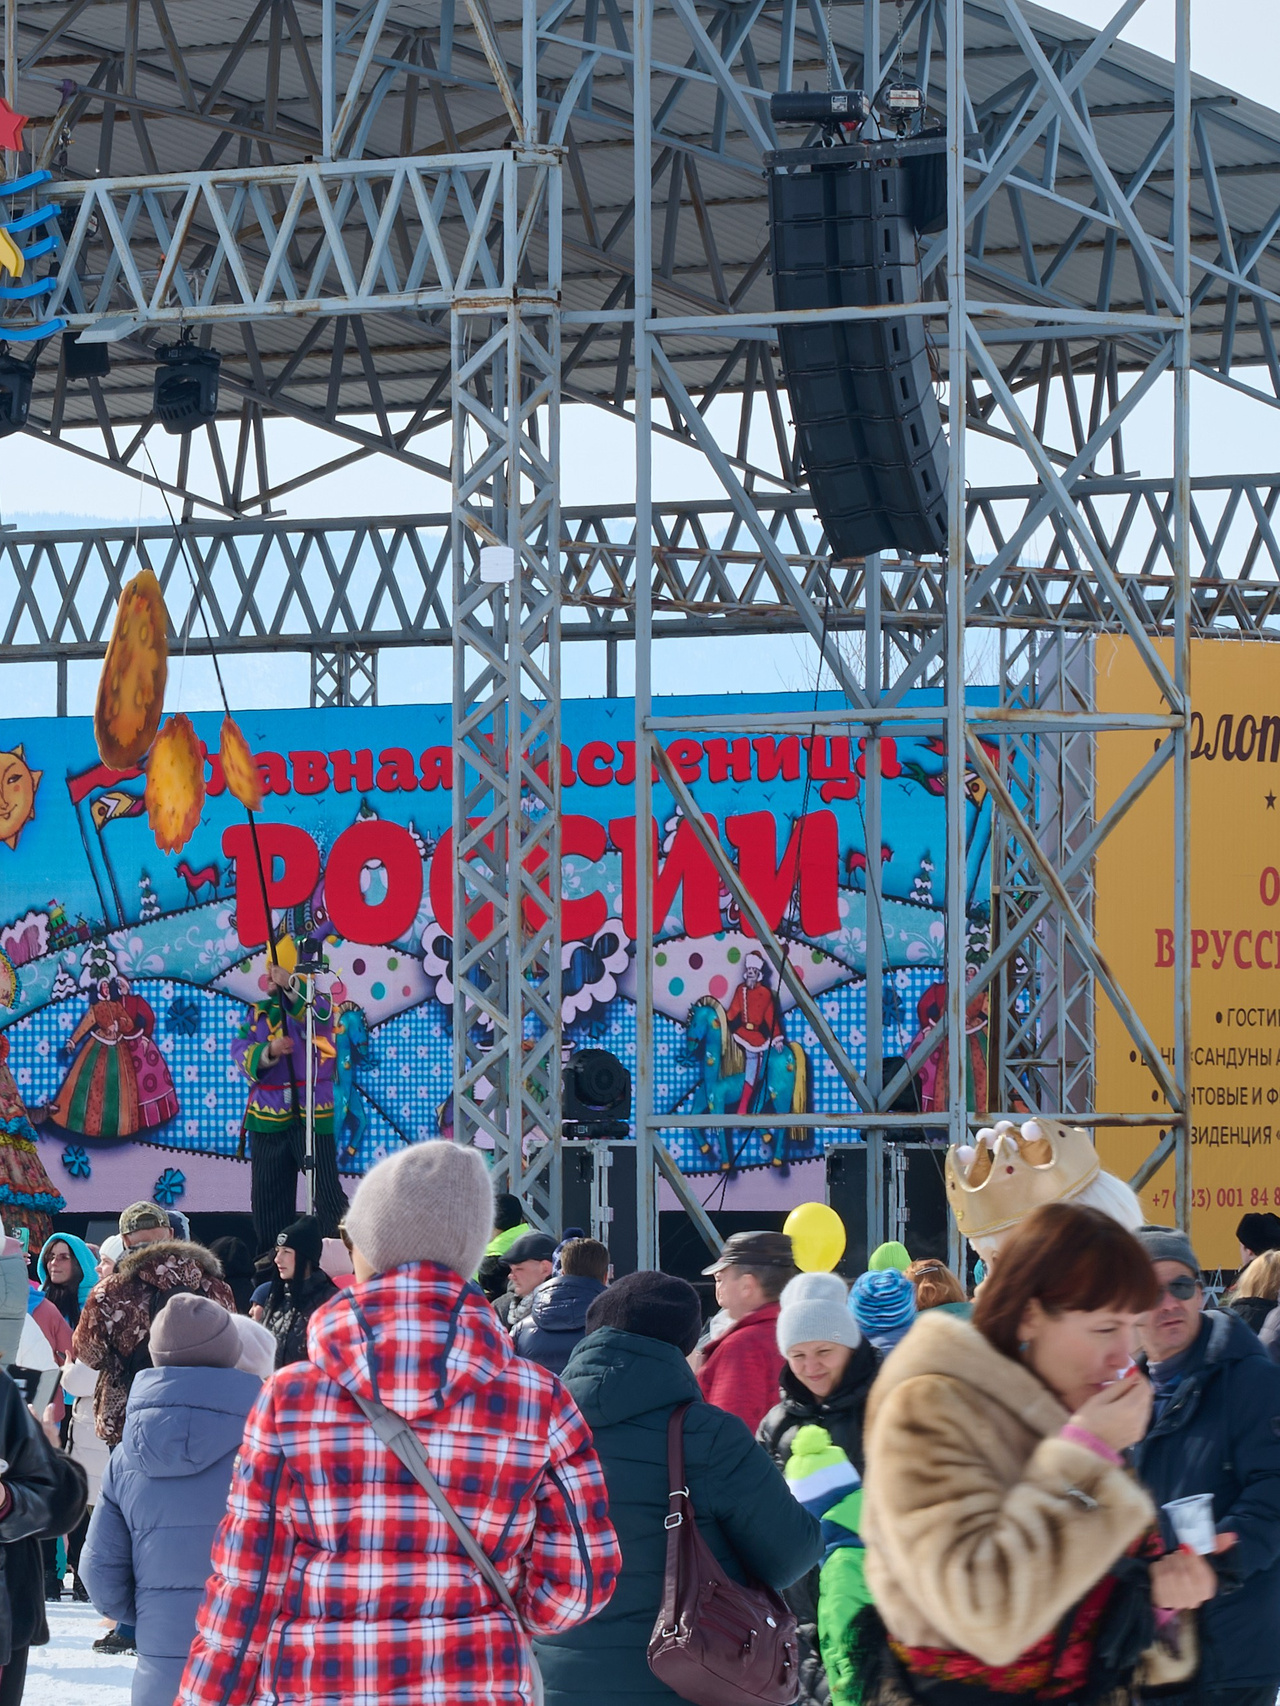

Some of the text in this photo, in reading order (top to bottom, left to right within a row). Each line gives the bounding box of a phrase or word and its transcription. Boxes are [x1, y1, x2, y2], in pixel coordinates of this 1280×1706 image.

[1190, 929, 1280, 970] РУСС
[1227, 1007, 1280, 1027] ГОСТИ
[1216, 1187, 1244, 1208] 001
[1250, 1187, 1269, 1207] 84
